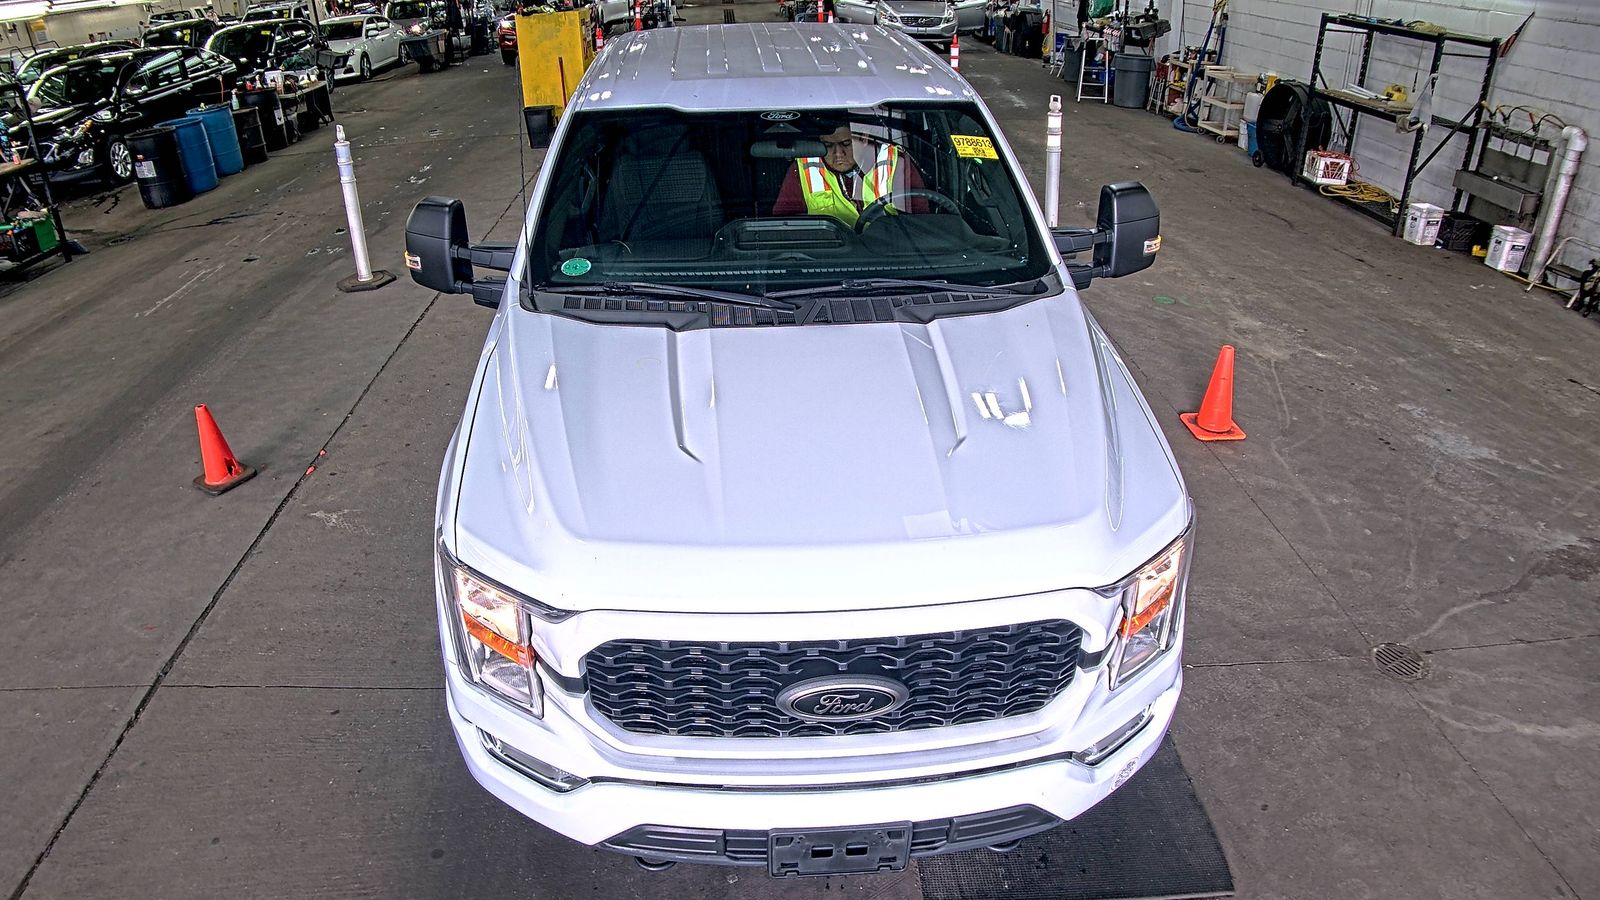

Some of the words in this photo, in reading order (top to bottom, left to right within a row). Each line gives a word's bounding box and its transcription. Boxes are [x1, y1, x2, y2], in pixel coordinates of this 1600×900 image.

[767, 111, 794, 119] Ford
[953, 137, 993, 149] 9788613
[813, 693, 875, 714] Ford
